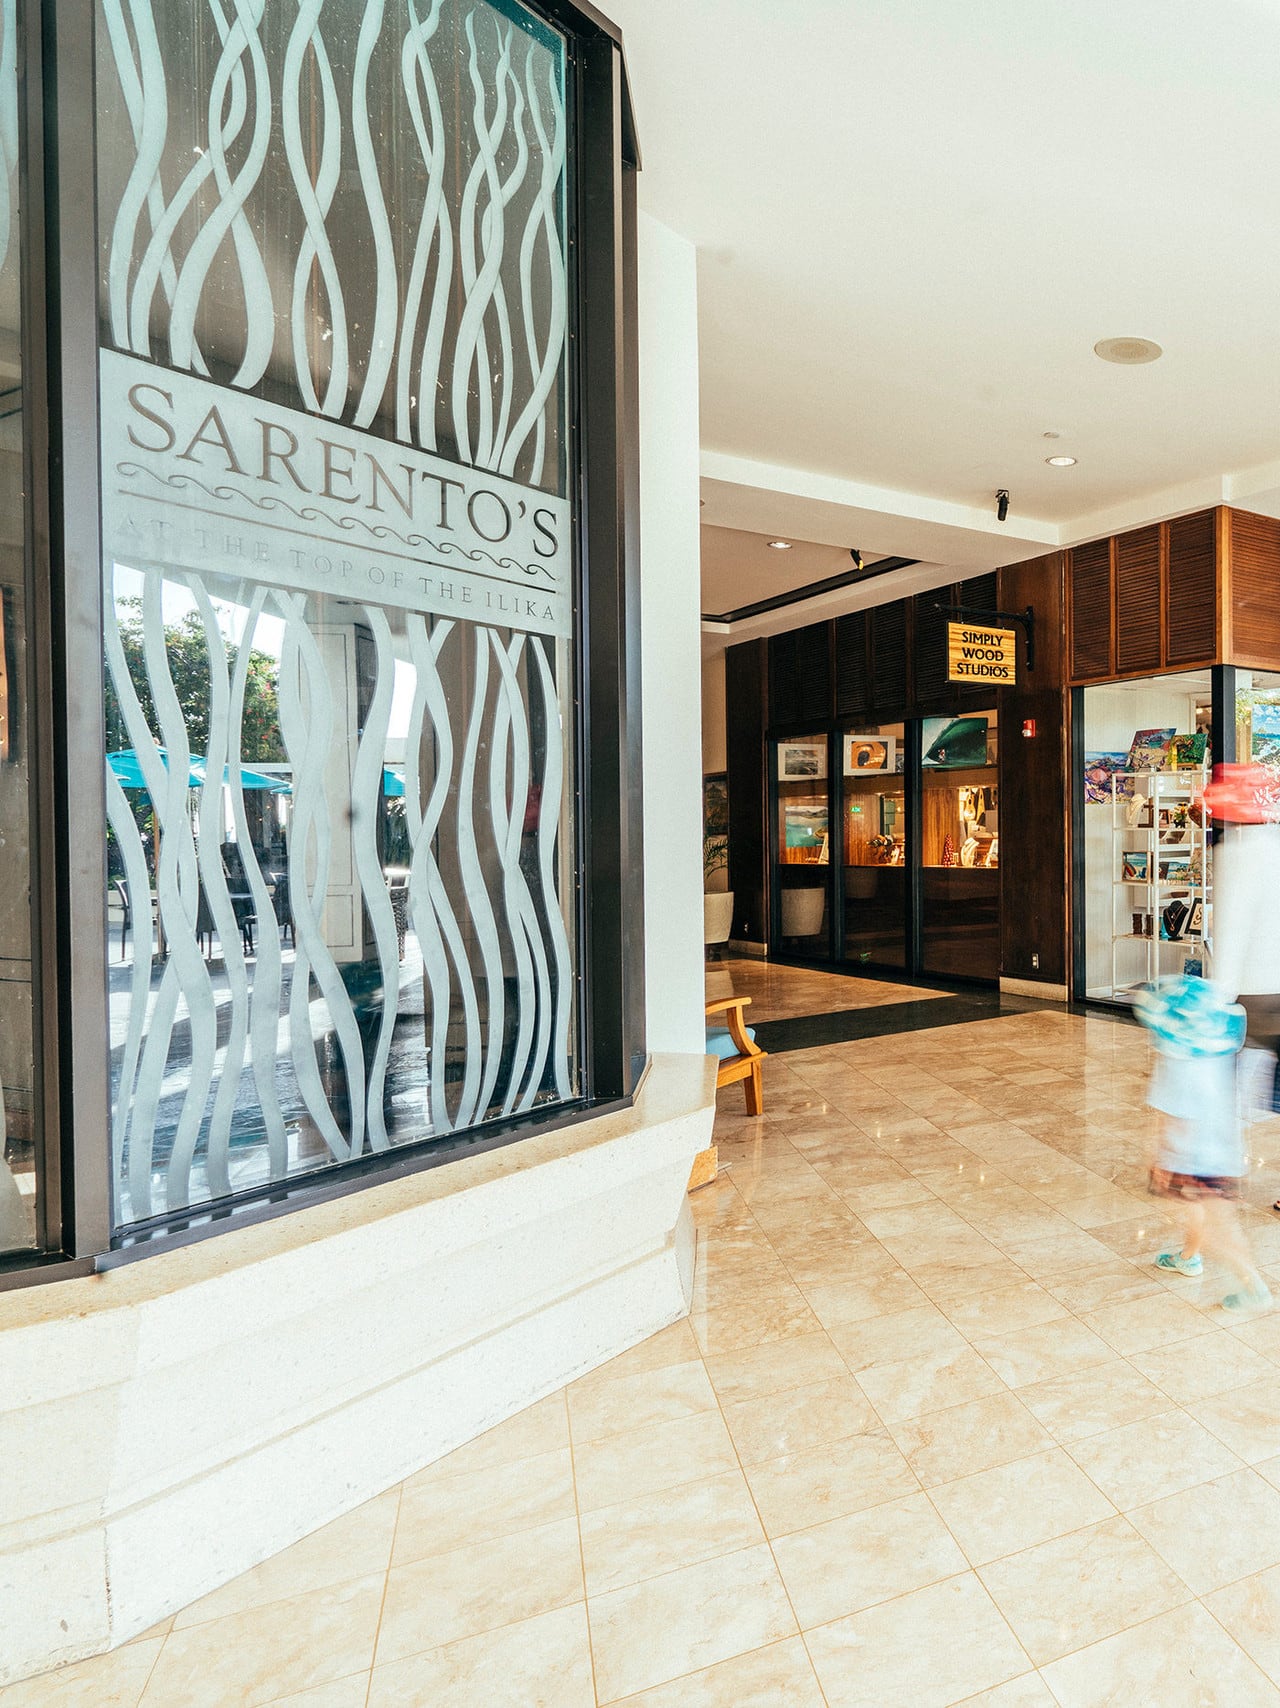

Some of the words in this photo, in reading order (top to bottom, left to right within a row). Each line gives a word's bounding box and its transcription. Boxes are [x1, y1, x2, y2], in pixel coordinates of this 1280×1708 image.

[127, 383, 559, 557] SARENTO'S
[195, 528, 271, 562] THE
[289, 548, 353, 577] TOP
[368, 566, 404, 588] OF
[418, 577, 473, 604] THE
[961, 631, 1003, 647] SIMPLY
[961, 647, 1004, 661] WOOD
[956, 662, 1009, 678] STUDIOS
